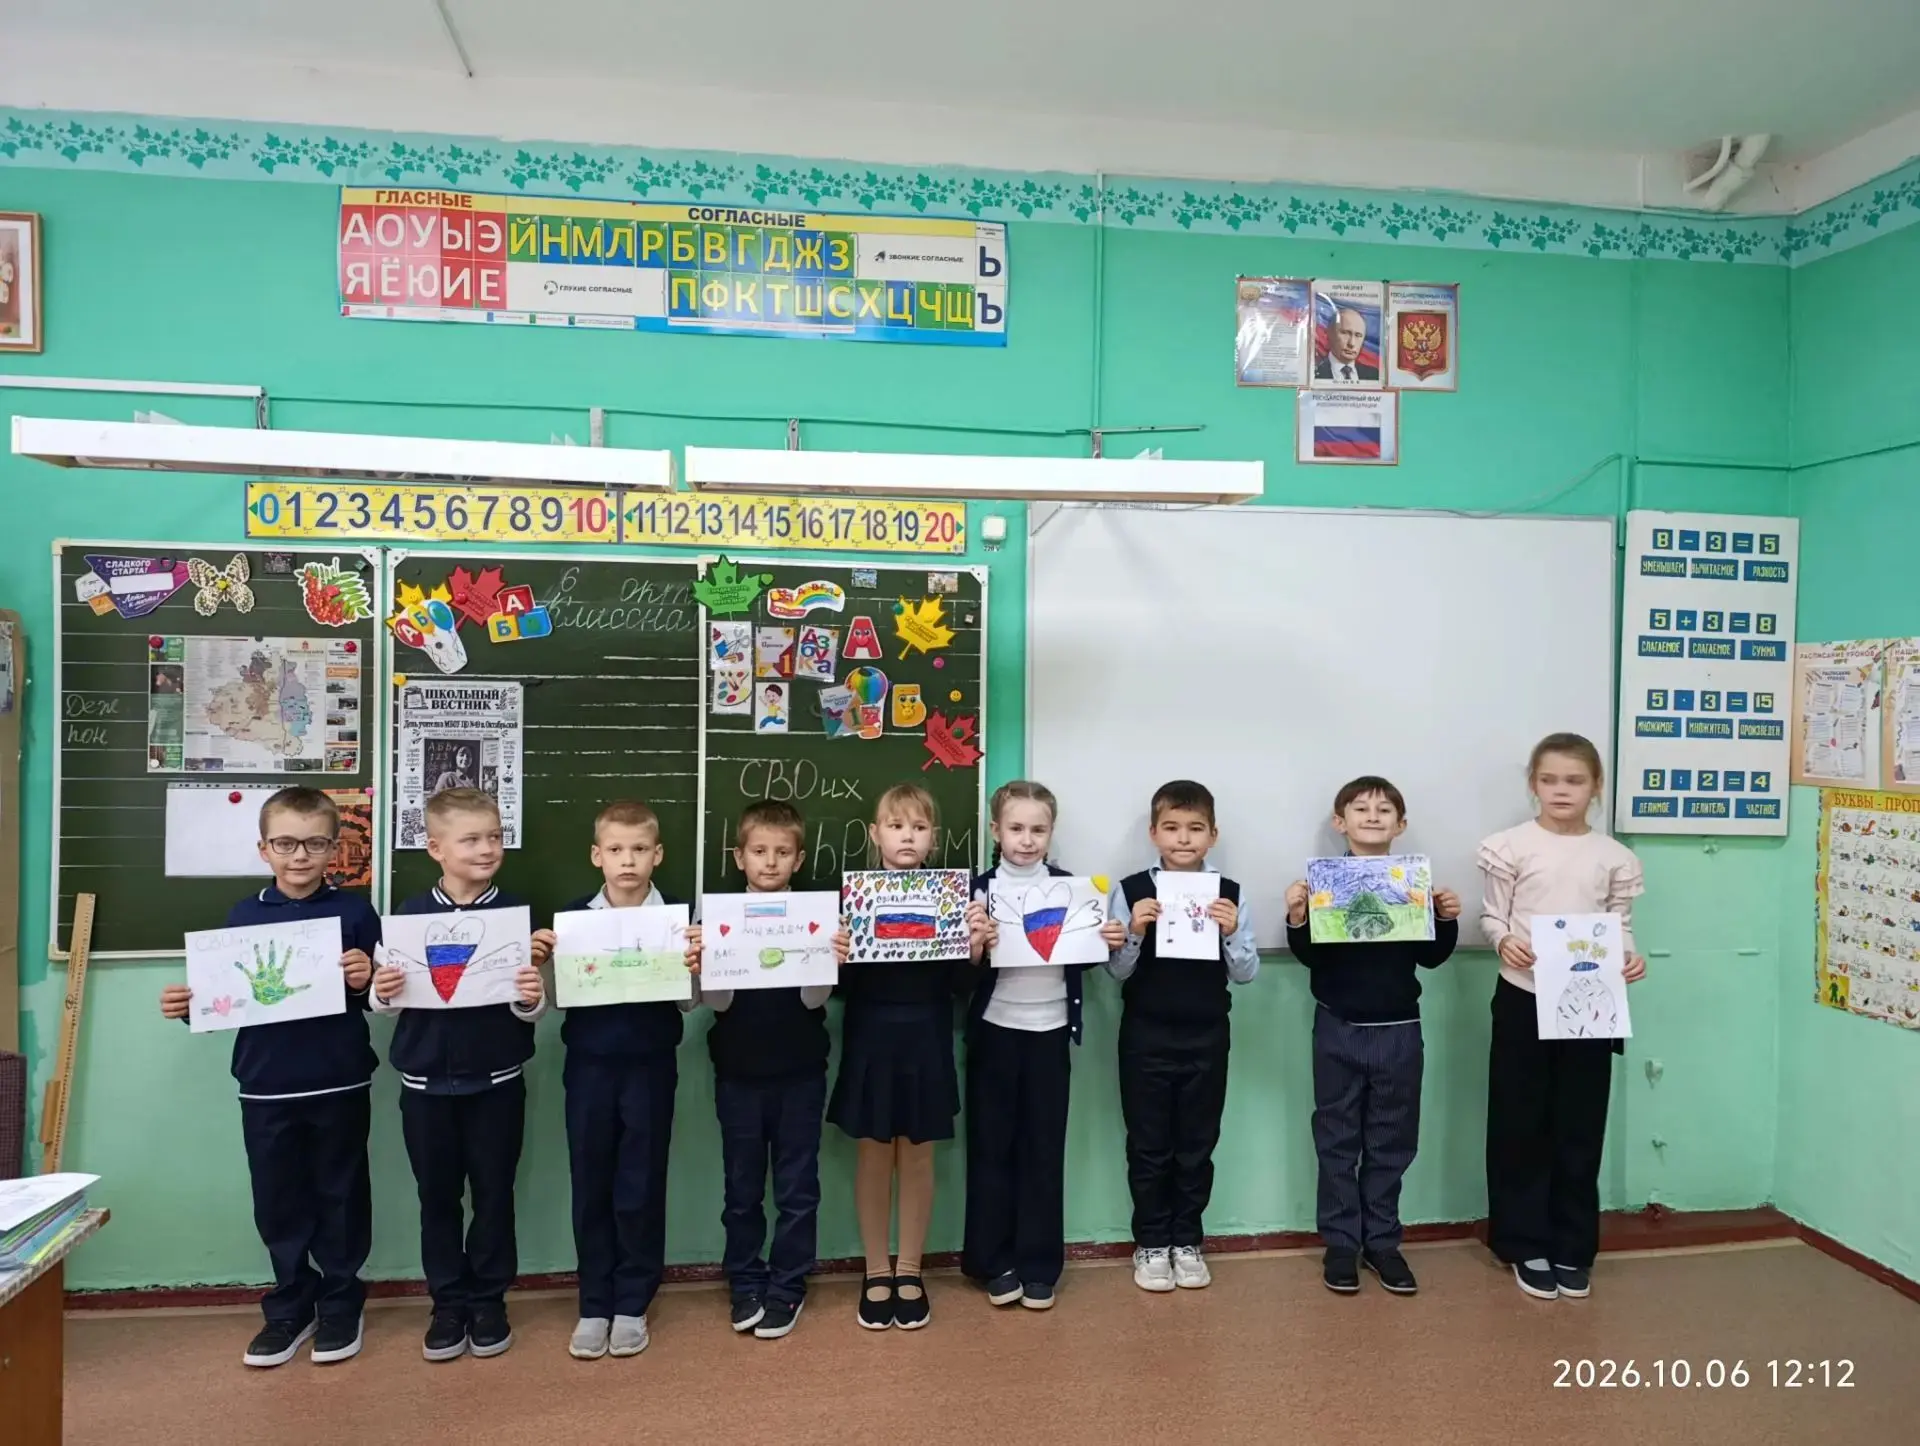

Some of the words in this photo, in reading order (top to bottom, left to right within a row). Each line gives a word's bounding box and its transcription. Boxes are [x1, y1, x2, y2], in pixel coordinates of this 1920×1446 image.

[375, 190, 472, 208] ГЛАСНЫЕ
[688, 207, 806, 228] СОГЛАСНЫЕ
[922, 255, 964, 263] СОГЛАСНЫЕ
[588, 286, 633, 294] СОГЛАСНЫЕ
[259, 493, 280, 525] 0
[285, 492, 302, 527] 1
[315, 492, 339, 528] 2
[349, 492, 371, 529] 3
[380, 494, 405, 529] 4
[412, 494, 436, 531] 5
[445, 495, 468, 532] 6
[478, 496, 499, 530] 7
[509, 496, 532, 532] 8
[541, 496, 563, 532] 9
[569, 497, 607, 533] 10
[633, 501, 657, 533] 11
[661, 501, 690, 535] 12
[695, 503, 723, 535] 13
[729, 504, 758, 536] 14
[763, 505, 791, 537] 15
[796, 506, 824, 538] 16
[828, 508, 856, 540] 17
[861, 509, 887, 541] 18
[892, 510, 919, 542] 19
[925, 512, 955, 543] 20
[1657, 532, 1669, 548] 8
[1710, 535, 1722, 550] 3
[1764, 537, 1776, 552] 5
[105, 560, 151, 569] СЛАДКОГО
[111, 567, 148, 576] СТАРТА!
[1691, 562, 1735, 576] ВЫЧИТАЕМОЕ
[1752, 565, 1786, 578] РАЗНОСТЬ
[560, 566, 580, 593] 6
[505, 593, 524, 612] А
[496, 620, 512, 637] Б
[1654, 612, 1667, 628] 5
[1707, 615, 1719, 630] 3
[1759, 617, 1771, 632] 8
[402, 624, 417, 642] А
[1641, 641, 1681, 653] СЛАГАЕМОЕ
[1692, 643, 1732, 656] СЛАГАЕМОЕ
[1752, 644, 1776, 657] СУММА
[425, 688, 500, 700] ШКОЛЬНЫЙ
[1652, 692, 1664, 707] 5
[1704, 694, 1716, 709] 3
[1755, 695, 1772, 708] 15
[431, 700, 492, 710] ВЕСТНИК
[1637, 721, 1674, 733] МНОЖИМОЕ
[1689, 722, 1730, 735] МНОЖИТЕЛЬ
[1648, 772, 1660, 787] 8
[1702, 773, 1714, 786] 2
[1754, 775, 1768, 788] 4
[1638, 801, 1670, 814] ДЕЛИМОЕ
[1690, 802, 1726, 814] ДЕЛИТЕЛЬ
[1745, 804, 1776, 816] ЧАСТНОЕ
[1834, 792, 1874, 809] БУКВЫ
